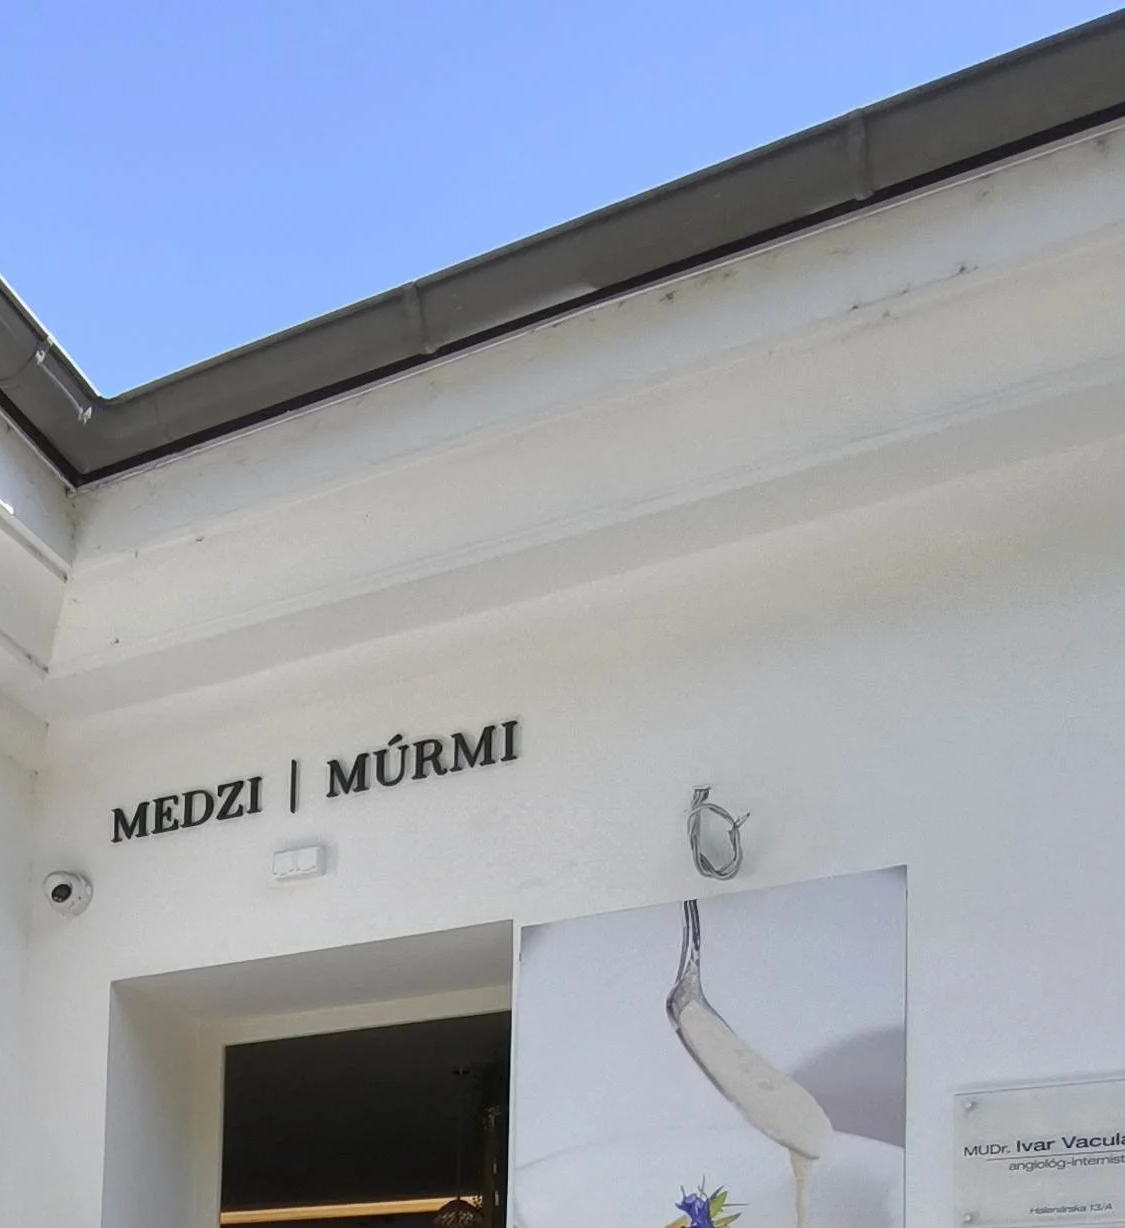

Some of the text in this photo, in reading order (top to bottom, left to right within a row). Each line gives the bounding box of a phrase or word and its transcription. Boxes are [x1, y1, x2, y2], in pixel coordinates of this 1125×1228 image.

[111, 776, 264, 843] MEDZI
[325, 720, 518, 799] MÚRMI
[964, 1143, 1011, 1157] MUDr.
[1016, 1139, 1056, 1153] Ivar
